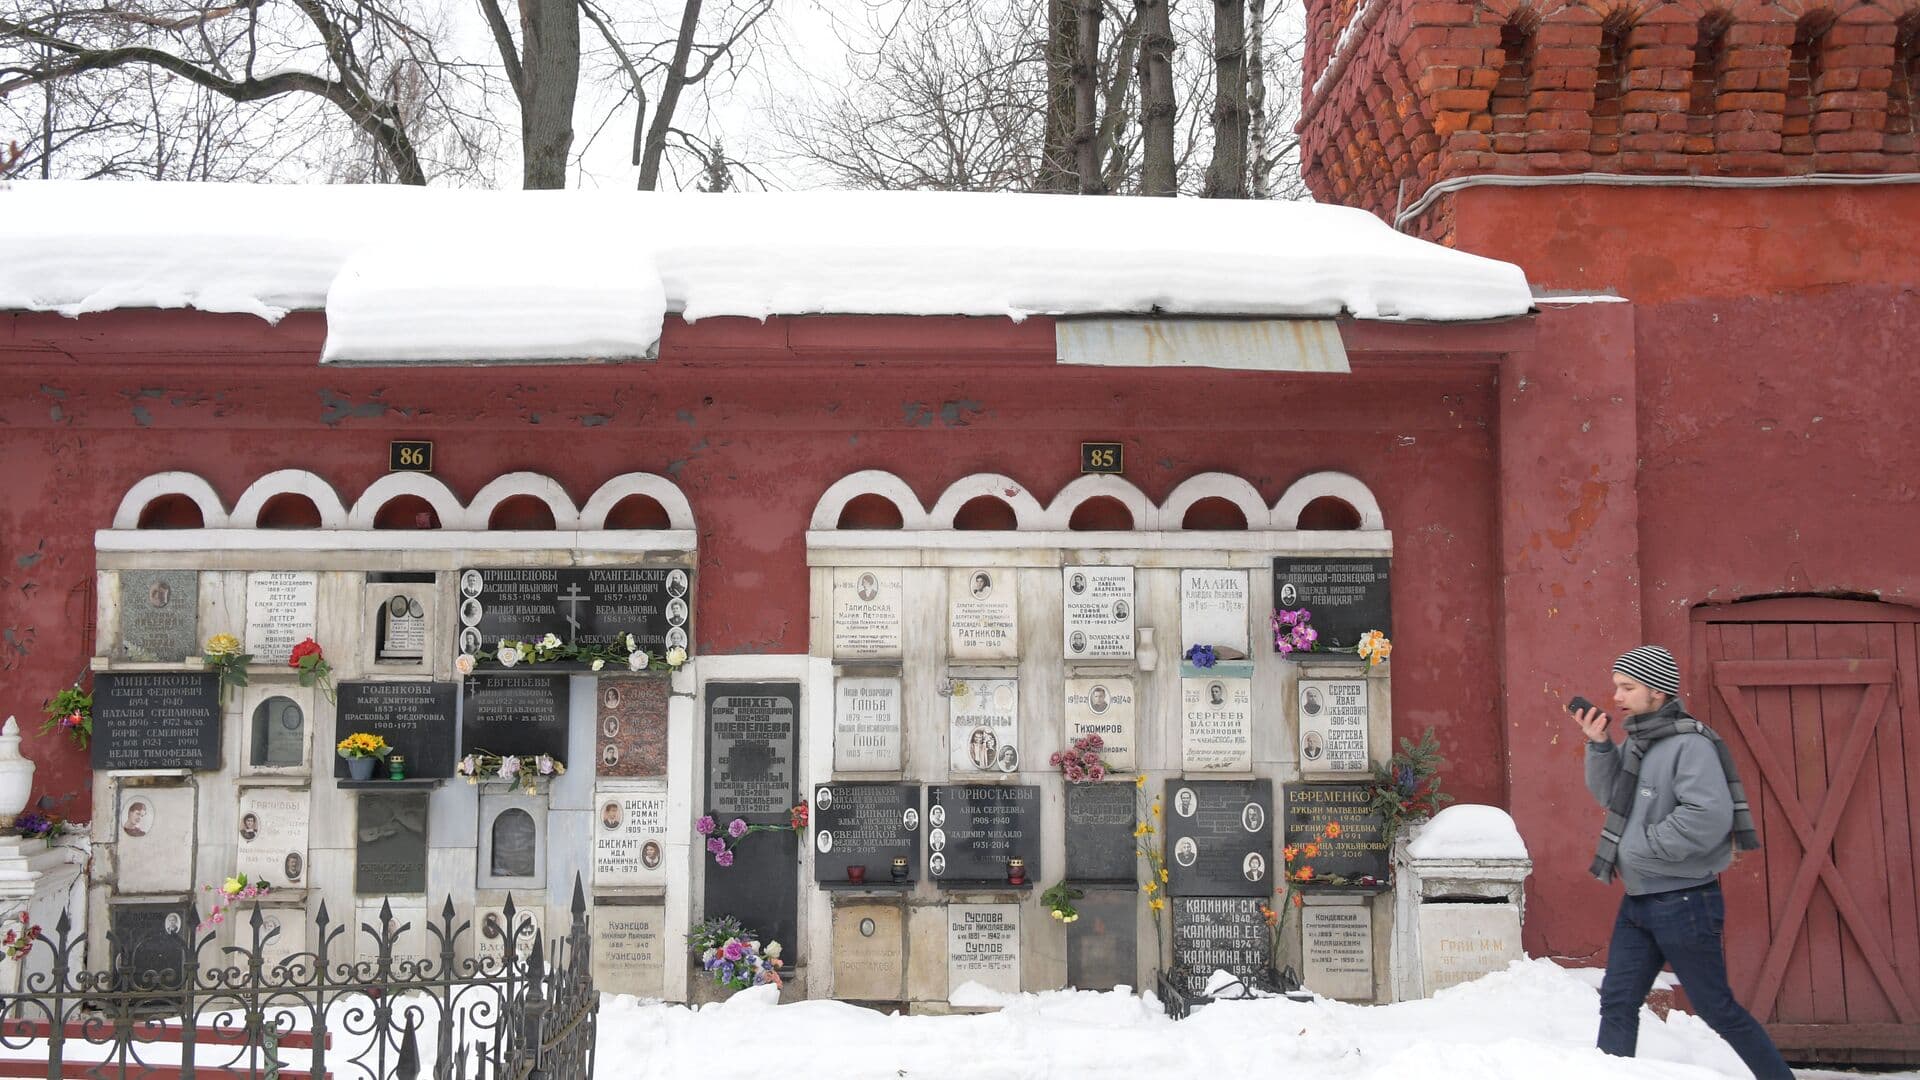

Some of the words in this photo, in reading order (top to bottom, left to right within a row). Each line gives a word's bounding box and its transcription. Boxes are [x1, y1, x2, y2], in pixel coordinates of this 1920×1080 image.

[400, 447, 424, 465] 86
[1091, 449, 1114, 467] 85
[588, 570, 666, 581] АРХАНГЕЛЬСКИЕ
[594, 583, 616, 593] ИВАН
[617, 583, 659, 593] ИВАНОВИЧ
[1191, 577, 1240, 590] МАЛИК
[114, 676, 202, 687] МИНЕНКОВЫ
[487, 678, 550, 687] ЕВГЕНЬЕВЫ
[362, 685, 432, 695] ГОЛЕНКОВЫ
[1328, 685, 1361, 696] СЕРГЕЕВ
[1335, 696, 1356, 706] ИВАН
[1327, 729, 1364, 740] СЕРГЕЕВА
[950, 788, 1033, 800] ГОРНОСТАЕВЫ
[1289, 791, 1370, 802] ЕФРЕМЕНКО
[624, 800, 665, 810] ДИСКАНТ
[959, 806, 982, 814] АННА
[832, 830, 896, 839] СВЕШНИКОВ
[598, 839, 638, 849] ДИСКАНТ
[1186, 899, 1236, 913] КАЛИНИН
[1191, 914, 1211, 923] 1894
[1231, 914, 1251, 923] 1940
[1183, 925, 1240, 939] КАЛИНИНА
[965, 942, 1003, 953] СУСЛОВ
[1192, 939, 1211, 948] 1900
[1232, 940, 1251, 948] 1974
[1183, 950, 1240, 964] КАЛИНИНА
[1192, 965, 1211, 974] 1923
[1232, 965, 1252, 974] 1994
